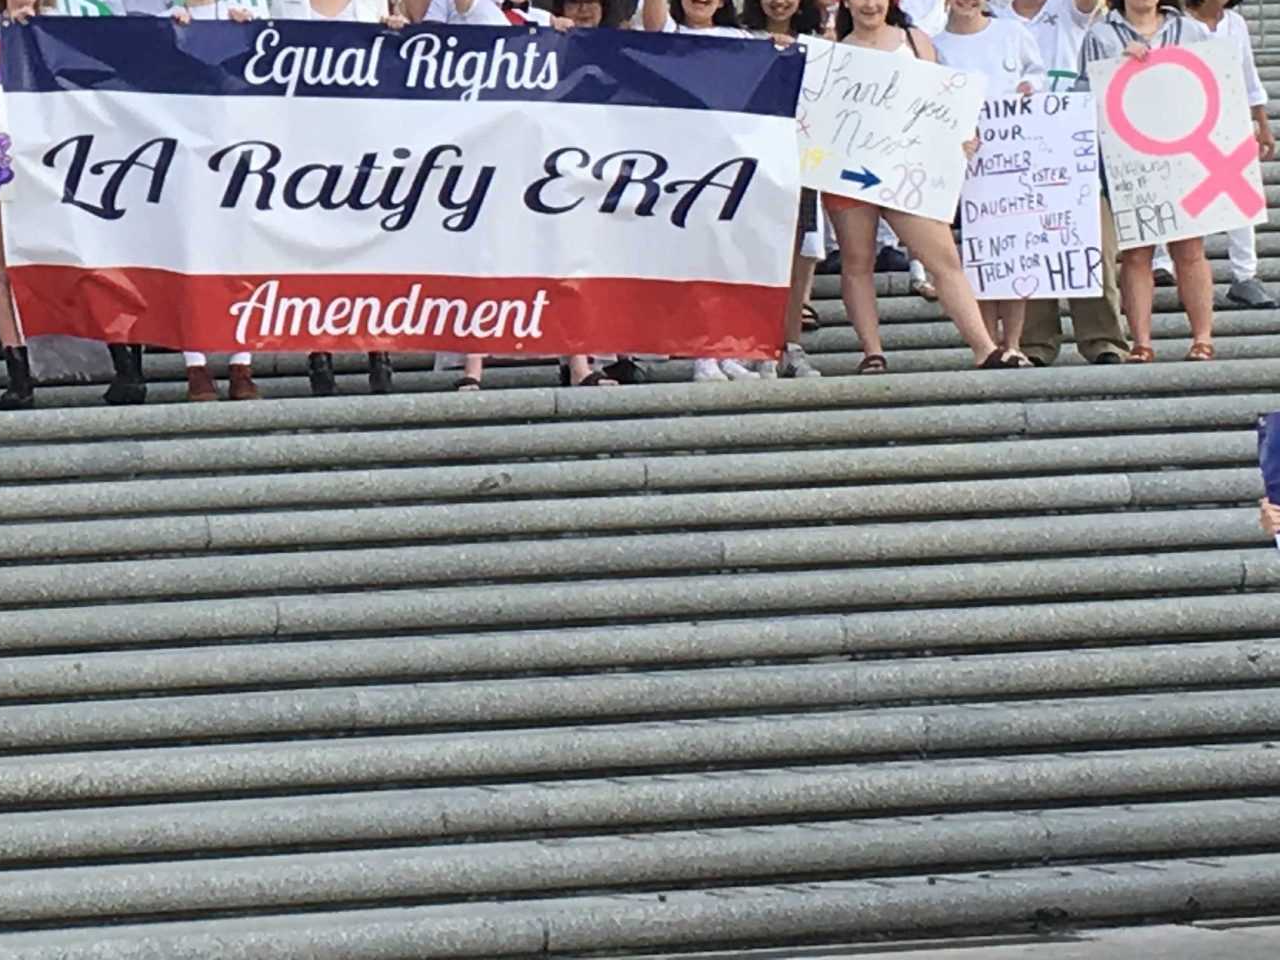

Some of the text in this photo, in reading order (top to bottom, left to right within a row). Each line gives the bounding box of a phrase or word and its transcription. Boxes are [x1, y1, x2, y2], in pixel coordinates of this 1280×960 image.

[243, 28, 559, 104] Equal Rights
[980, 95, 1071, 120] HINK OF
[42, 134, 759, 233] LA Ratify ERA
[965, 150, 1031, 180] MOTHER
[965, 193, 1046, 224] DAUGHTER
[1114, 200, 1178, 242] ERA
[965, 237, 984, 264] IF
[990, 234, 1016, 257] NOT
[1025, 231, 1049, 250] FOR
[966, 247, 1104, 293] THEN FOR HER
[229, 280, 551, 346] Amendment
